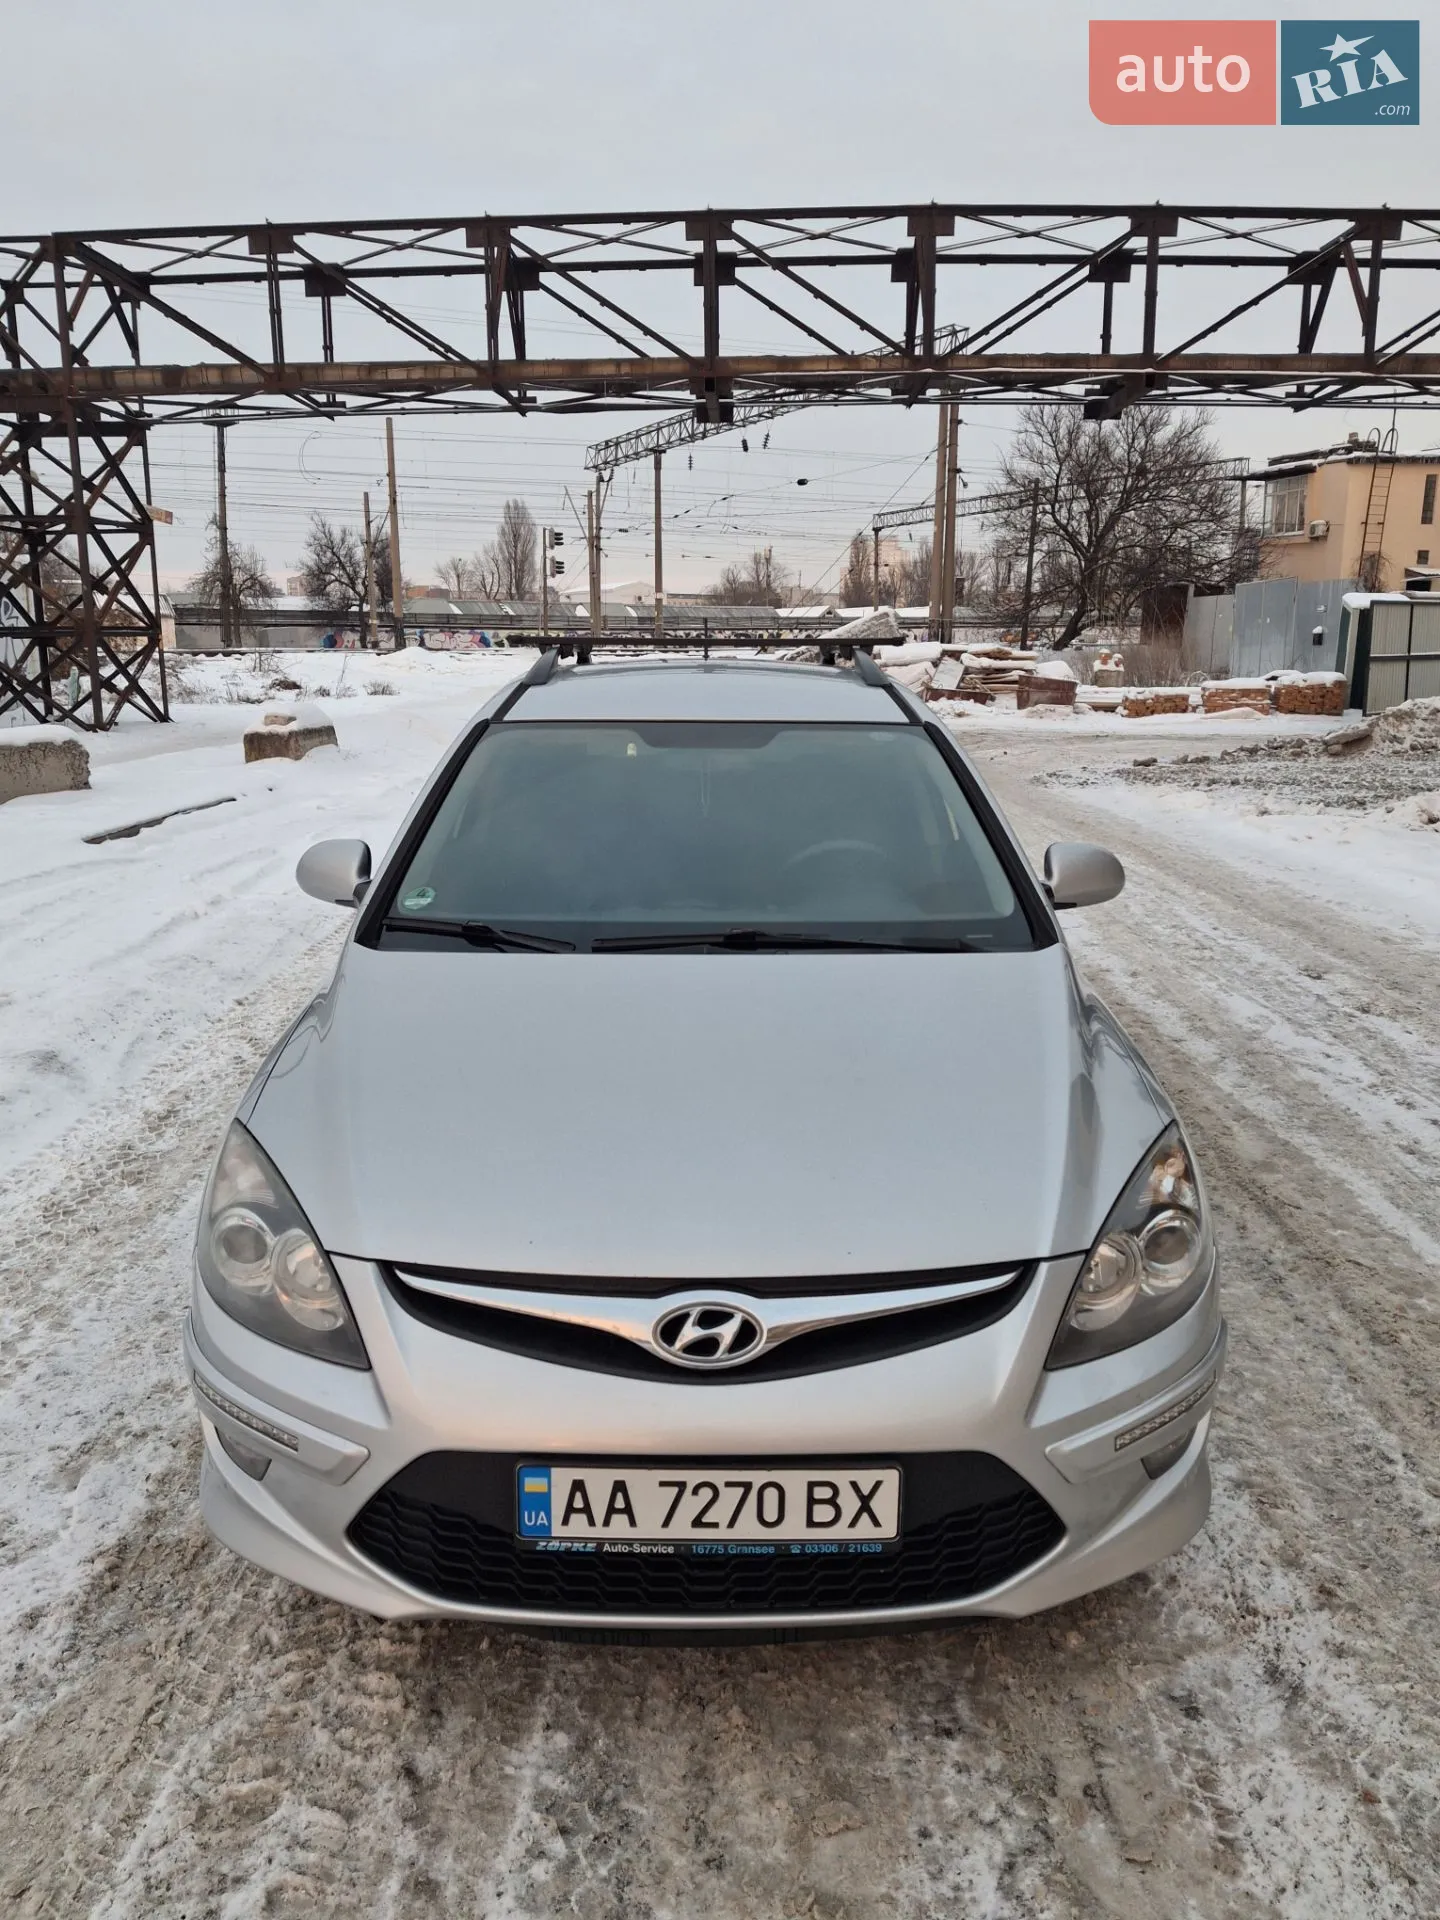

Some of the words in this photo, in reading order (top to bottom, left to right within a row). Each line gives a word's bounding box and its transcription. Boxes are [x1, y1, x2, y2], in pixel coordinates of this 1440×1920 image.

[560, 1479, 637, 1528] AA
[658, 1480, 786, 1529] 7270
[806, 1480, 884, 1529] BX
[524, 1510, 549, 1527] UA
[602, 1543, 675, 1554] Auto-Service
[691, 1544, 725, 1554] 16775
[848, 1543, 882, 1553] 21639
